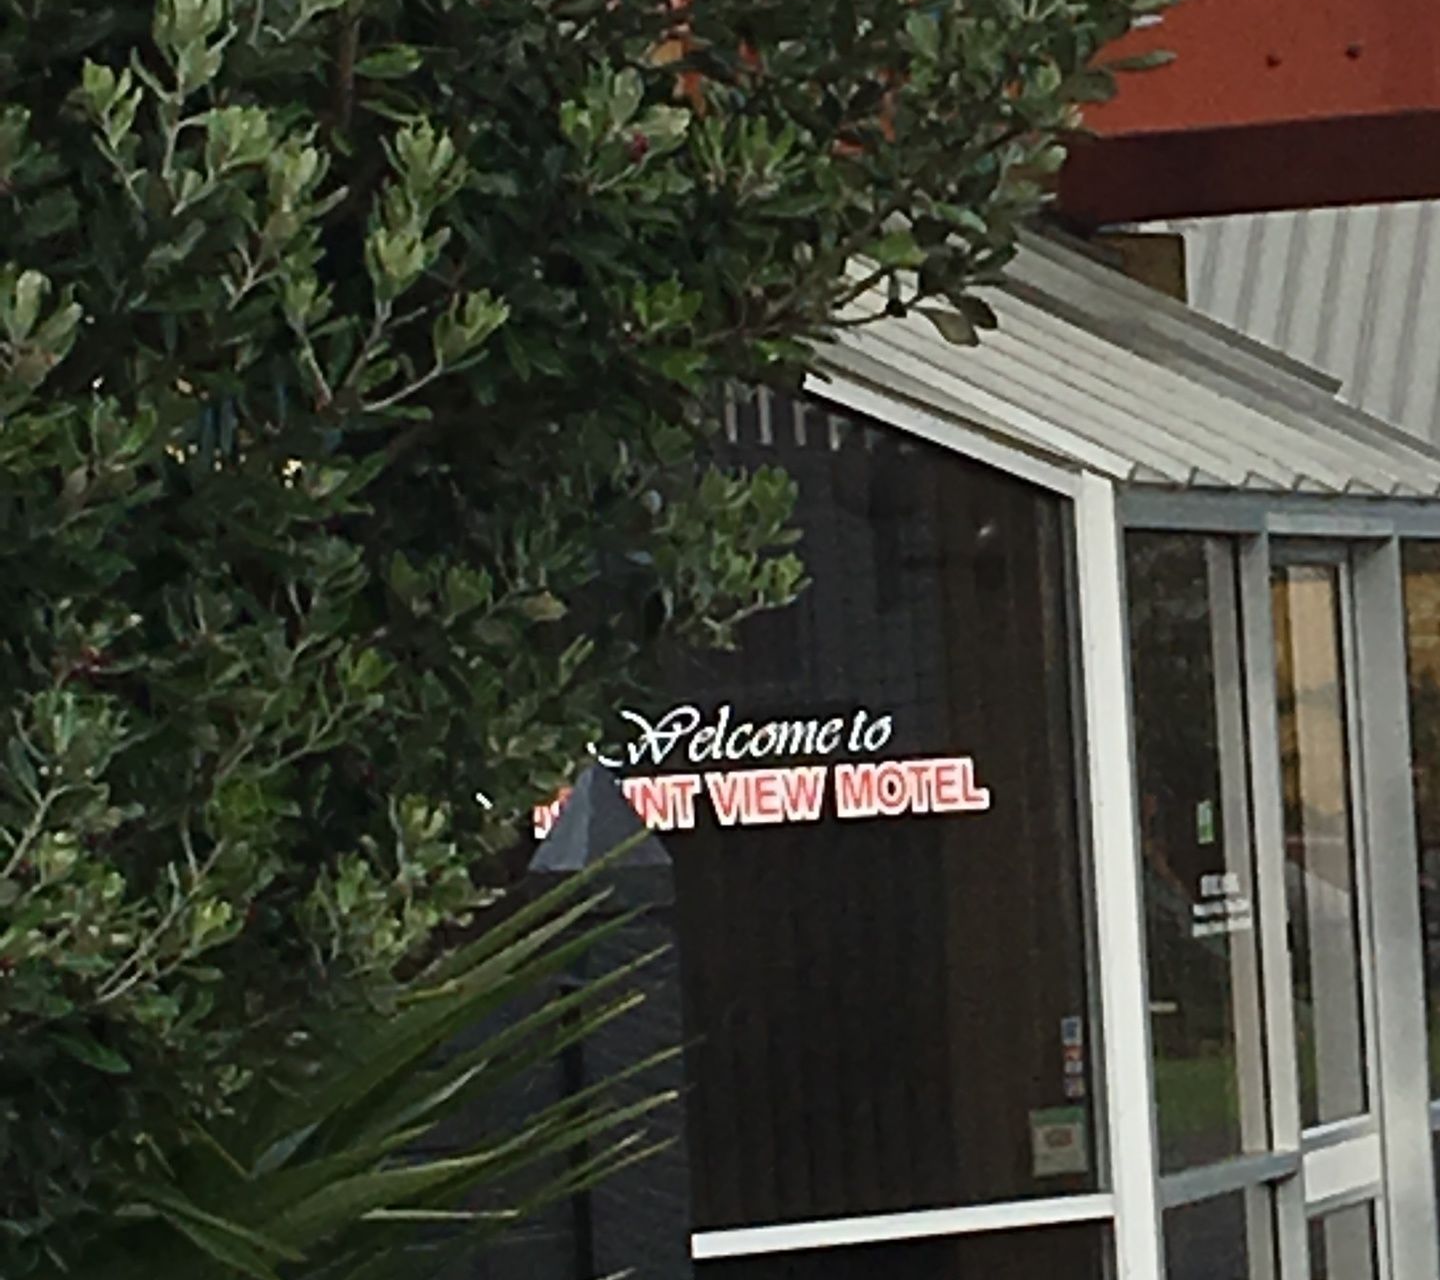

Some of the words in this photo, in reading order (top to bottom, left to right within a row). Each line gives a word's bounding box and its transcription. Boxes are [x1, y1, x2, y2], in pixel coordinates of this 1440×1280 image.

[587, 705, 844, 767] Welcome
[848, 710, 892, 753] to
[704, 766, 827, 827] VIEW
[834, 756, 990, 818] MOTEL
